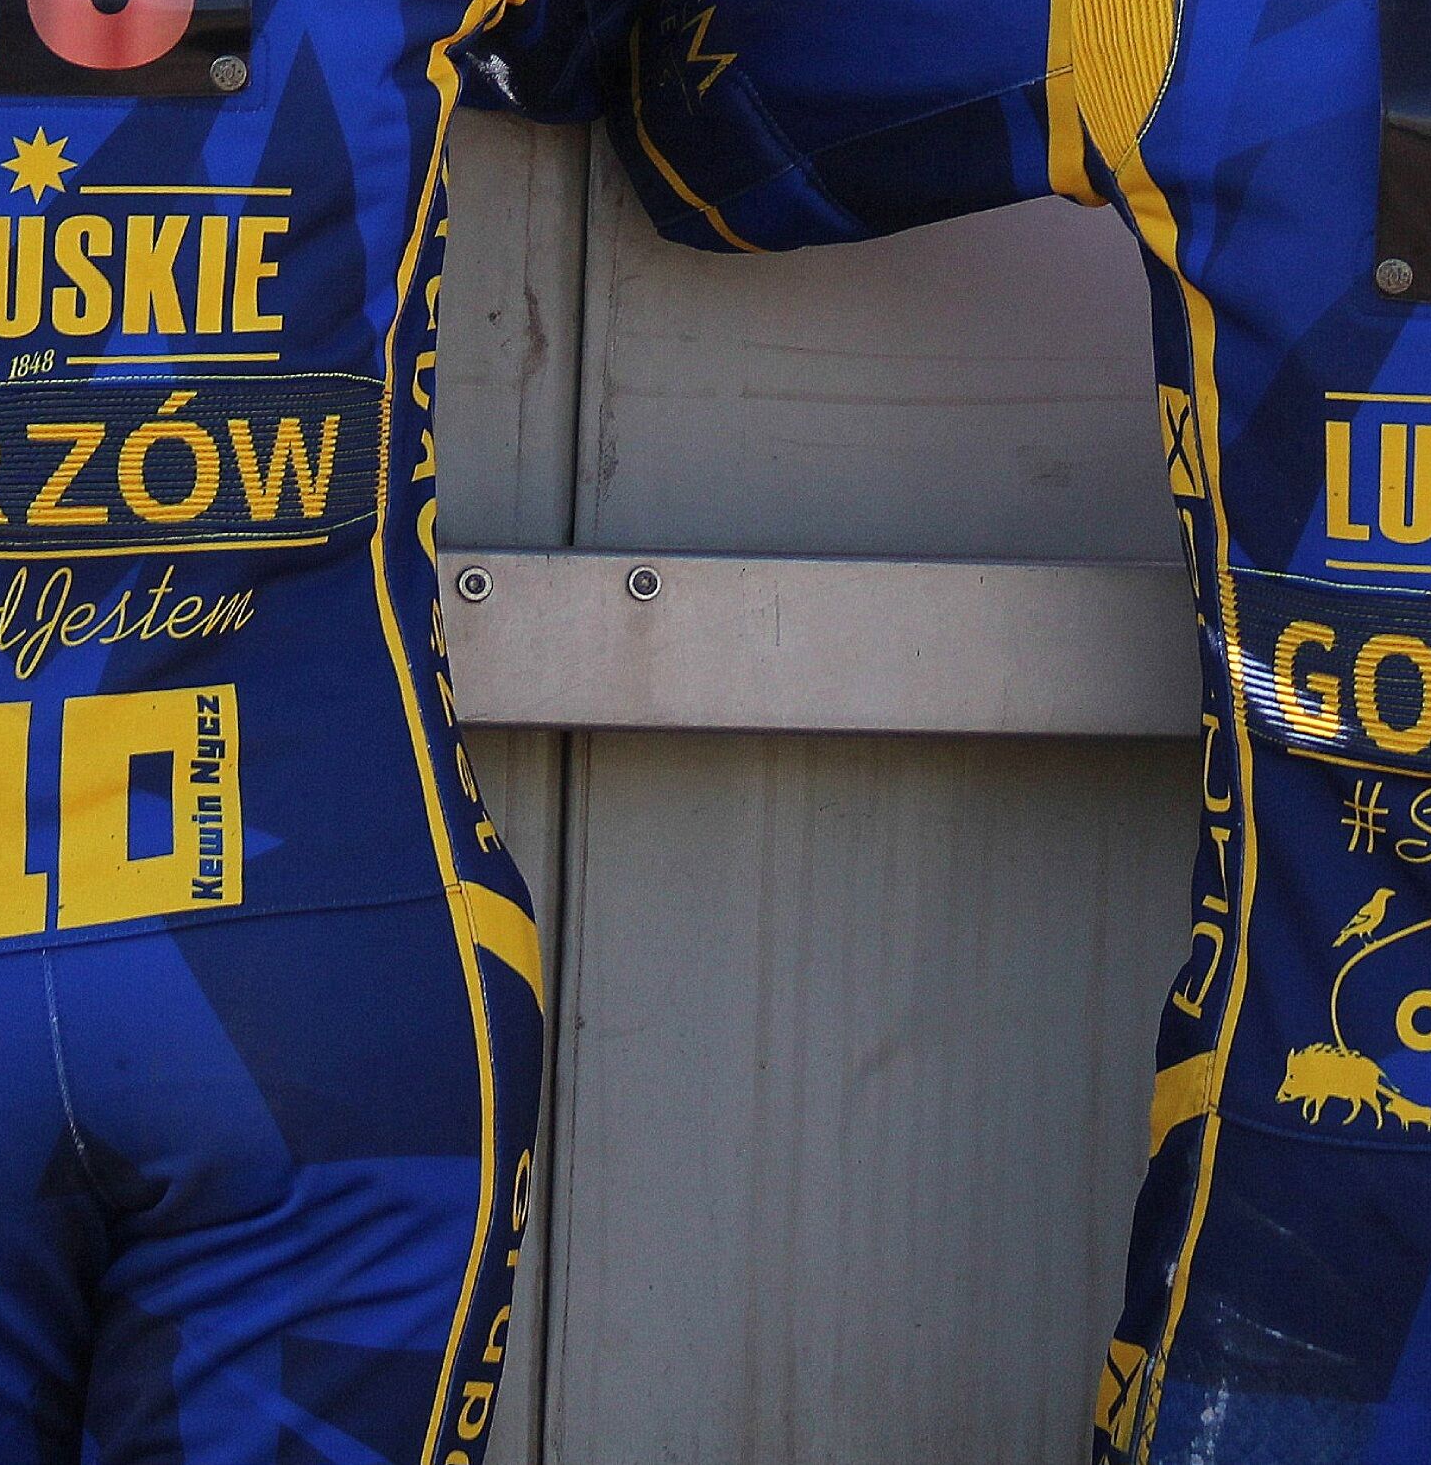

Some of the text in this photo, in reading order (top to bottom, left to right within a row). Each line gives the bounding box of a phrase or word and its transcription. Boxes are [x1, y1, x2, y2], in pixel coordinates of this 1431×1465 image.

[8, 349, 55, 380] 1848
[189, 694, 227, 901] Kewin Nycz
